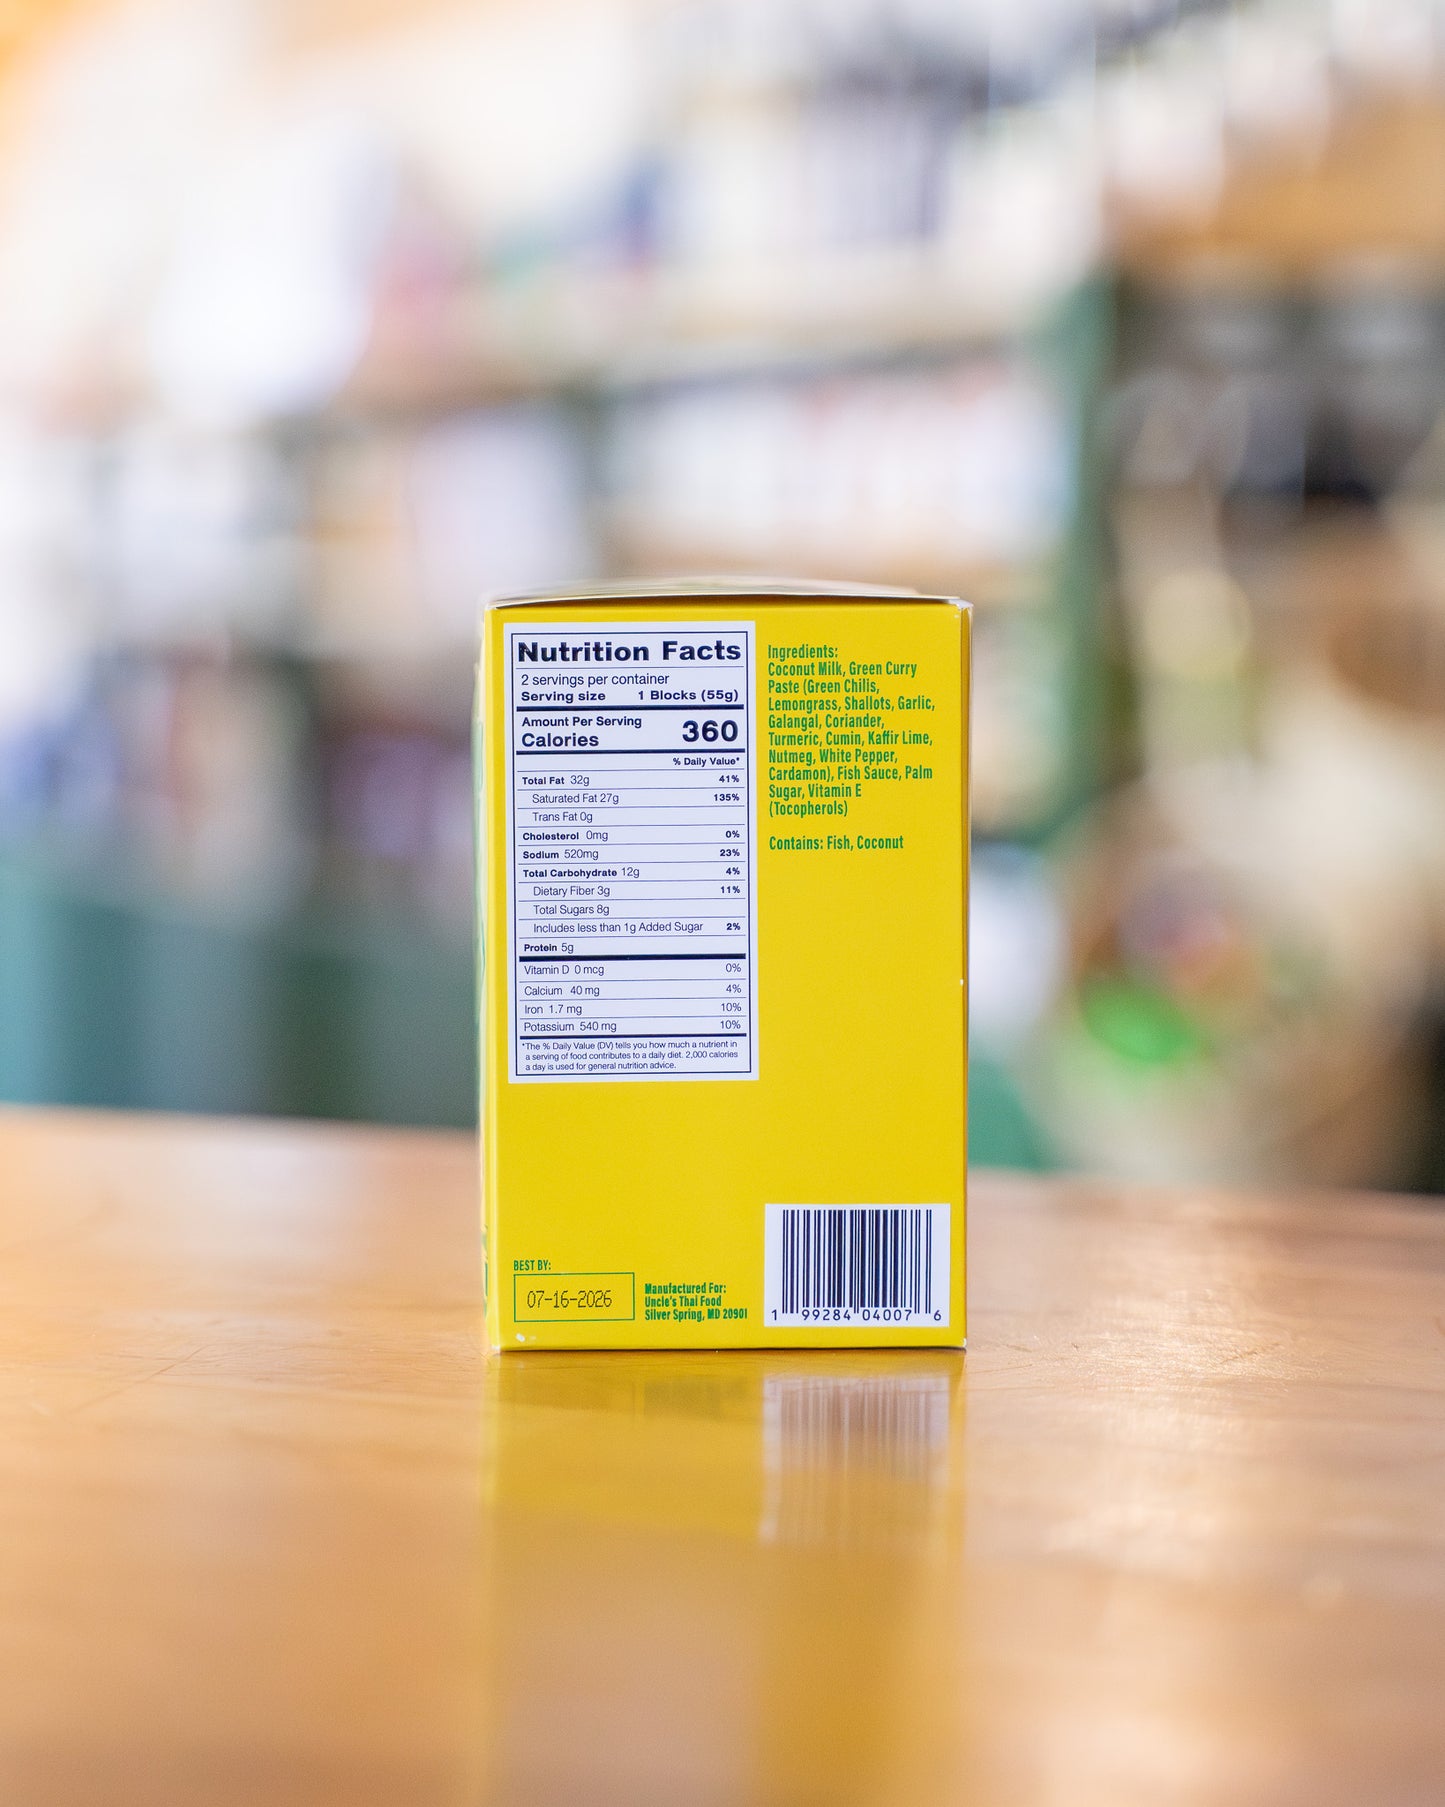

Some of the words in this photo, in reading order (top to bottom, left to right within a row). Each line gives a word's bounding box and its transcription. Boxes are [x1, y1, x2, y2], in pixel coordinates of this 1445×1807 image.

[518, 642, 649, 662] Nutrition
[663, 640, 741, 660] Facts
[768, 644, 838, 662] Ingredients:
[768, 661, 815, 676] Coconut
[818, 661, 845, 677] Milk,
[849, 661, 882, 675] Green
[886, 661, 917, 678] Curry
[521, 674, 529, 685] 2
[533, 674, 584, 688] servings
[588, 676, 608, 687] per
[612, 673, 669, 685] container
[768, 680, 799, 693] Paste
[803, 679, 840, 695] (Green
[844, 678, 879, 694] Chilis,
[521, 691, 573, 703] Serving
[578, 691, 605, 701] size
[638, 691, 643, 700] 1
[651, 690, 696, 700] Blocks
[701, 689, 738, 702] (55g)
[769, 697, 841, 715] Lemongrass,
[845, 696, 894, 711] Shallots,
[898, 695, 935, 711] Garlic,
[522, 717, 569, 726] Amount
[573, 717, 593, 726] Per
[596, 716, 641, 729] Serving
[768, 714, 822, 731] Galangal,
[825, 713, 884, 729] Coriander,
[682, 720, 738, 742] 360
[522, 733, 599, 747] Calories
[768, 731, 822, 747] Turmeric,
[826, 731, 864, 746] Cumin,
[868, 730, 899, 745] Kaffir
[902, 730, 932, 746] Lime,
[684, 758, 706, 767] Daily
[769, 749, 816, 766] Nutmeg,
[820, 748, 851, 763] White
[855, 748, 897, 766] Pepper,
[719, 775, 739, 783] 41%
[769, 766, 834, 782] Cardamon),
[838, 765, 860, 780] Fish
[864, 766, 901, 781] Sauce,
[905, 765, 932, 779] Palm
[522, 777, 546, 785] Total
[570, 775, 589, 786] 32g
[714, 793, 739, 801] 135%
[769, 784, 804, 801] Sugar,
[808, 783, 852, 797] Vitamin
[856, 783, 861, 797] E
[532, 794, 579, 803] Saturated
[583, 793, 597, 802] Fat
[600, 793, 619, 805] 27g
[770, 800, 848, 818] (Tocopherols)
[533, 812, 560, 821] Trans
[563, 812, 577, 821] Fat
[580, 812, 592, 823] 0g
[523, 832, 579, 840] Cholesterol
[586, 830, 608, 842] 0mg
[726, 830, 740, 838] 0%
[769, 836, 823, 850] Contains:
[827, 835, 853, 851] Fish,
[857, 835, 903, 849] Coconut
[523, 851, 559, 859] Sodium
[564, 849, 598, 860] 520mg
[523, 869, 547, 877] Total
[550, 869, 617, 879] Carbohydrate
[622, 867, 639, 878] 12g
[726, 867, 740, 875] 4%
[534, 887, 567, 897] Dietary
[570, 886, 595, 895] Fiber
[597, 886, 610, 897] 3g
[533, 905, 557, 914] Total
[560, 905, 594, 916] Sugars
[597, 904, 609, 916] 8g
[534, 923, 575, 933] Includes
[578, 923, 597, 932] less
[600, 923, 621, 932] than
[625, 923, 636, 934] 1g
[639, 922, 671, 931] Added
[675, 922, 703, 933] Sugar
[524, 944, 557, 952] Protein
[562, 943, 574, 954] 5g
[524, 965, 559, 974] Vitamin
[562, 965, 569, 974] D
[575, 965, 581, 974] 0
[584, 967, 604, 976] mcg
[726, 963, 741, 972] 0%
[524, 986, 562, 996] Calcium
[570, 986, 582, 995] 40
[585, 987, 599, 997] mg
[726, 984, 741, 993] 4%
[525, 1005, 543, 1014] Iron
[550, 1004, 563, 1013] 1.7
[567, 1006, 582, 1016] mg
[721, 1003, 741, 1012] 10%
[524, 1022, 574, 1032] Potassium
[580, 1021, 598, 1031] 540
[601, 1023, 616, 1033] mg
[720, 1020, 741, 1029] 10%
[553, 1042, 571, 1051] Daily
[597, 1042, 613, 1050] (DV)
[532, 1054, 558, 1062] serving
[561, 1052, 568, 1060] of
[649, 1052, 665, 1060] daily
[686, 1051, 707, 1059] 2,000
[532, 1064, 545, 1072] day
[588, 1063, 616, 1071] general
[650, 1061, 676, 1069] advice.
[514, 1260, 534, 1271] BEST
[538, 1260, 551, 1270] BY:
[645, 1282, 706, 1294] Manufactured
[709, 1282, 726, 1293] For:
[527, 1290, 612, 1308] 07-16-2026
[645, 1296, 677, 1307] Uncle's
[679, 1296, 698, 1306] Thai
[700, 1295, 721, 1306] Food
[645, 1309, 670, 1320] Silver
[673, 1308, 704, 1322] Spring,
[708, 1309, 720, 1319] MD
[723, 1308, 747, 1319] 20901
[772, 1309, 777, 1320] 1
[802, 1309, 851, 1321] 99284
[862, 1309, 912, 1321] 04007
[934, 1310, 941, 1321] 6
